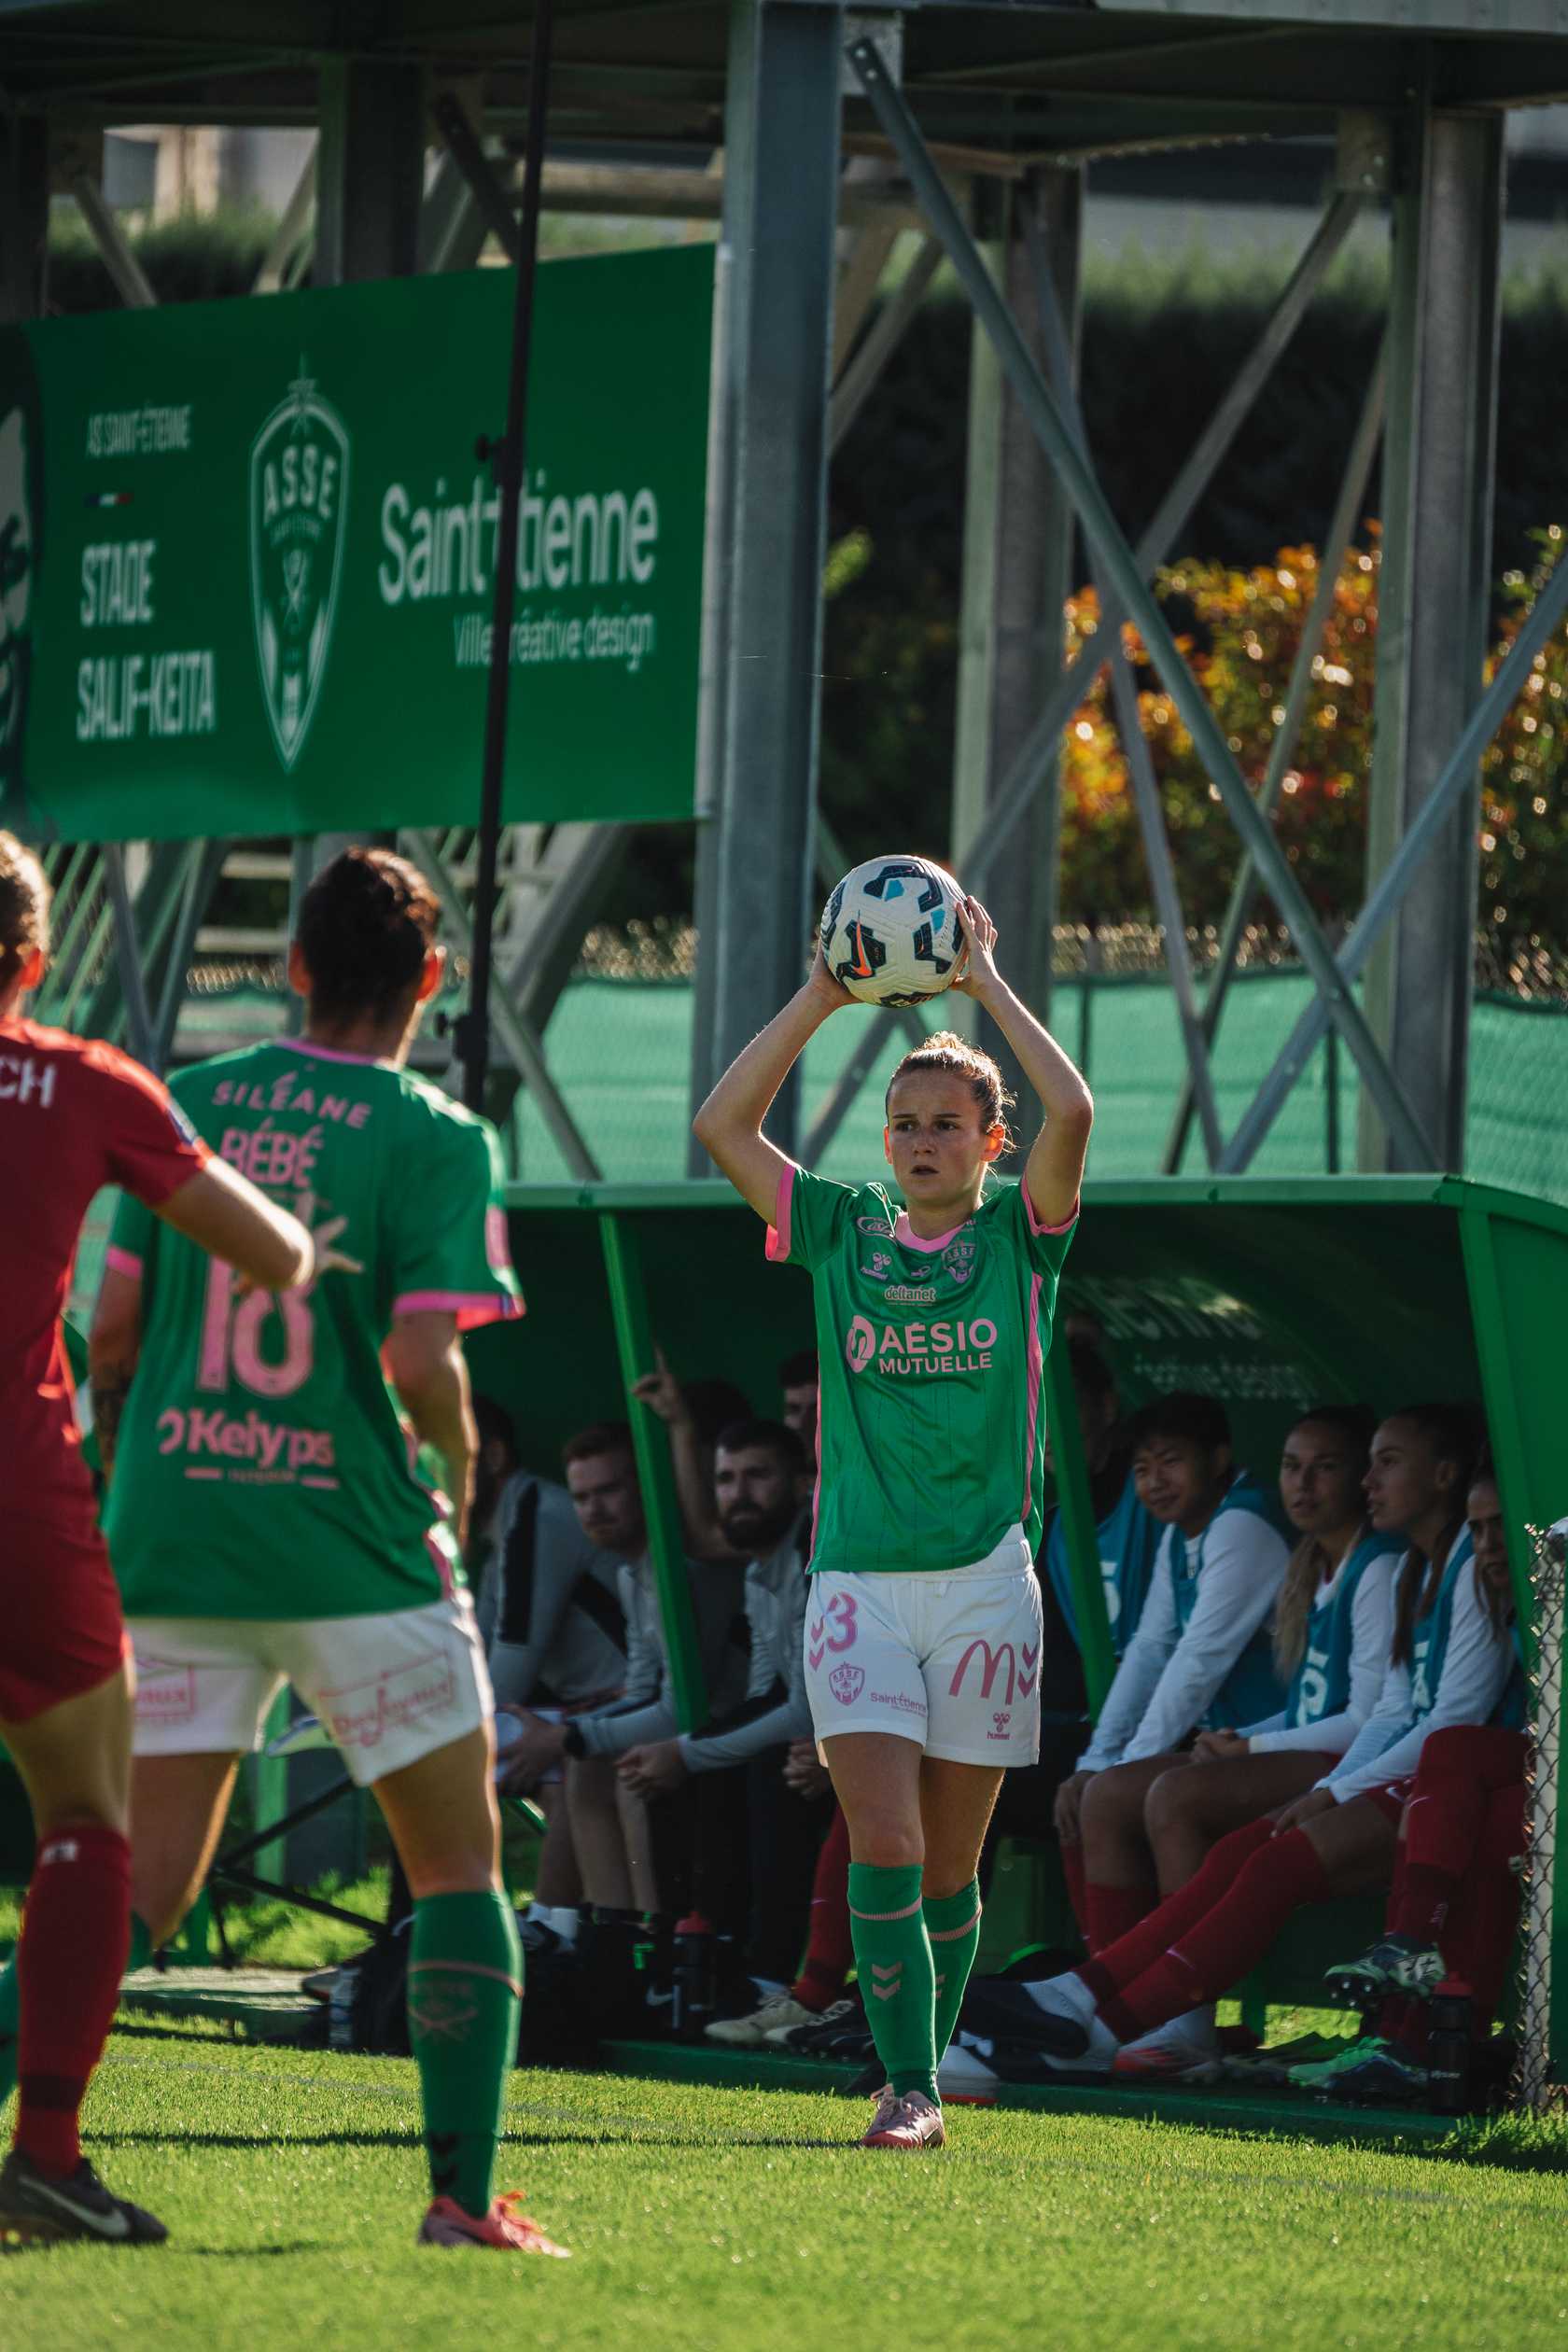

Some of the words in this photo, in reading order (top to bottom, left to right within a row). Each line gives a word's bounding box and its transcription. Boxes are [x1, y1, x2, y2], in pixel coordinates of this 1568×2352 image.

[262, 444, 337, 528] ASSE
[80, 539, 156, 627] STADE
[454, 612, 494, 667] Ville
[508, 608, 582, 664] réative
[584, 604, 655, 673] design
[77, 650, 216, 742] SALIF-KEITA
[211, 1070, 372, 1130] SILÉANE
[885, 1283, 937, 1302] deltanet
[877, 1351, 994, 1375] MUTUELLE
[878, 1317, 999, 1355] AÉSIO
[188, 1407, 335, 1469] Kelyps
[827, 1591, 859, 1654] 3
